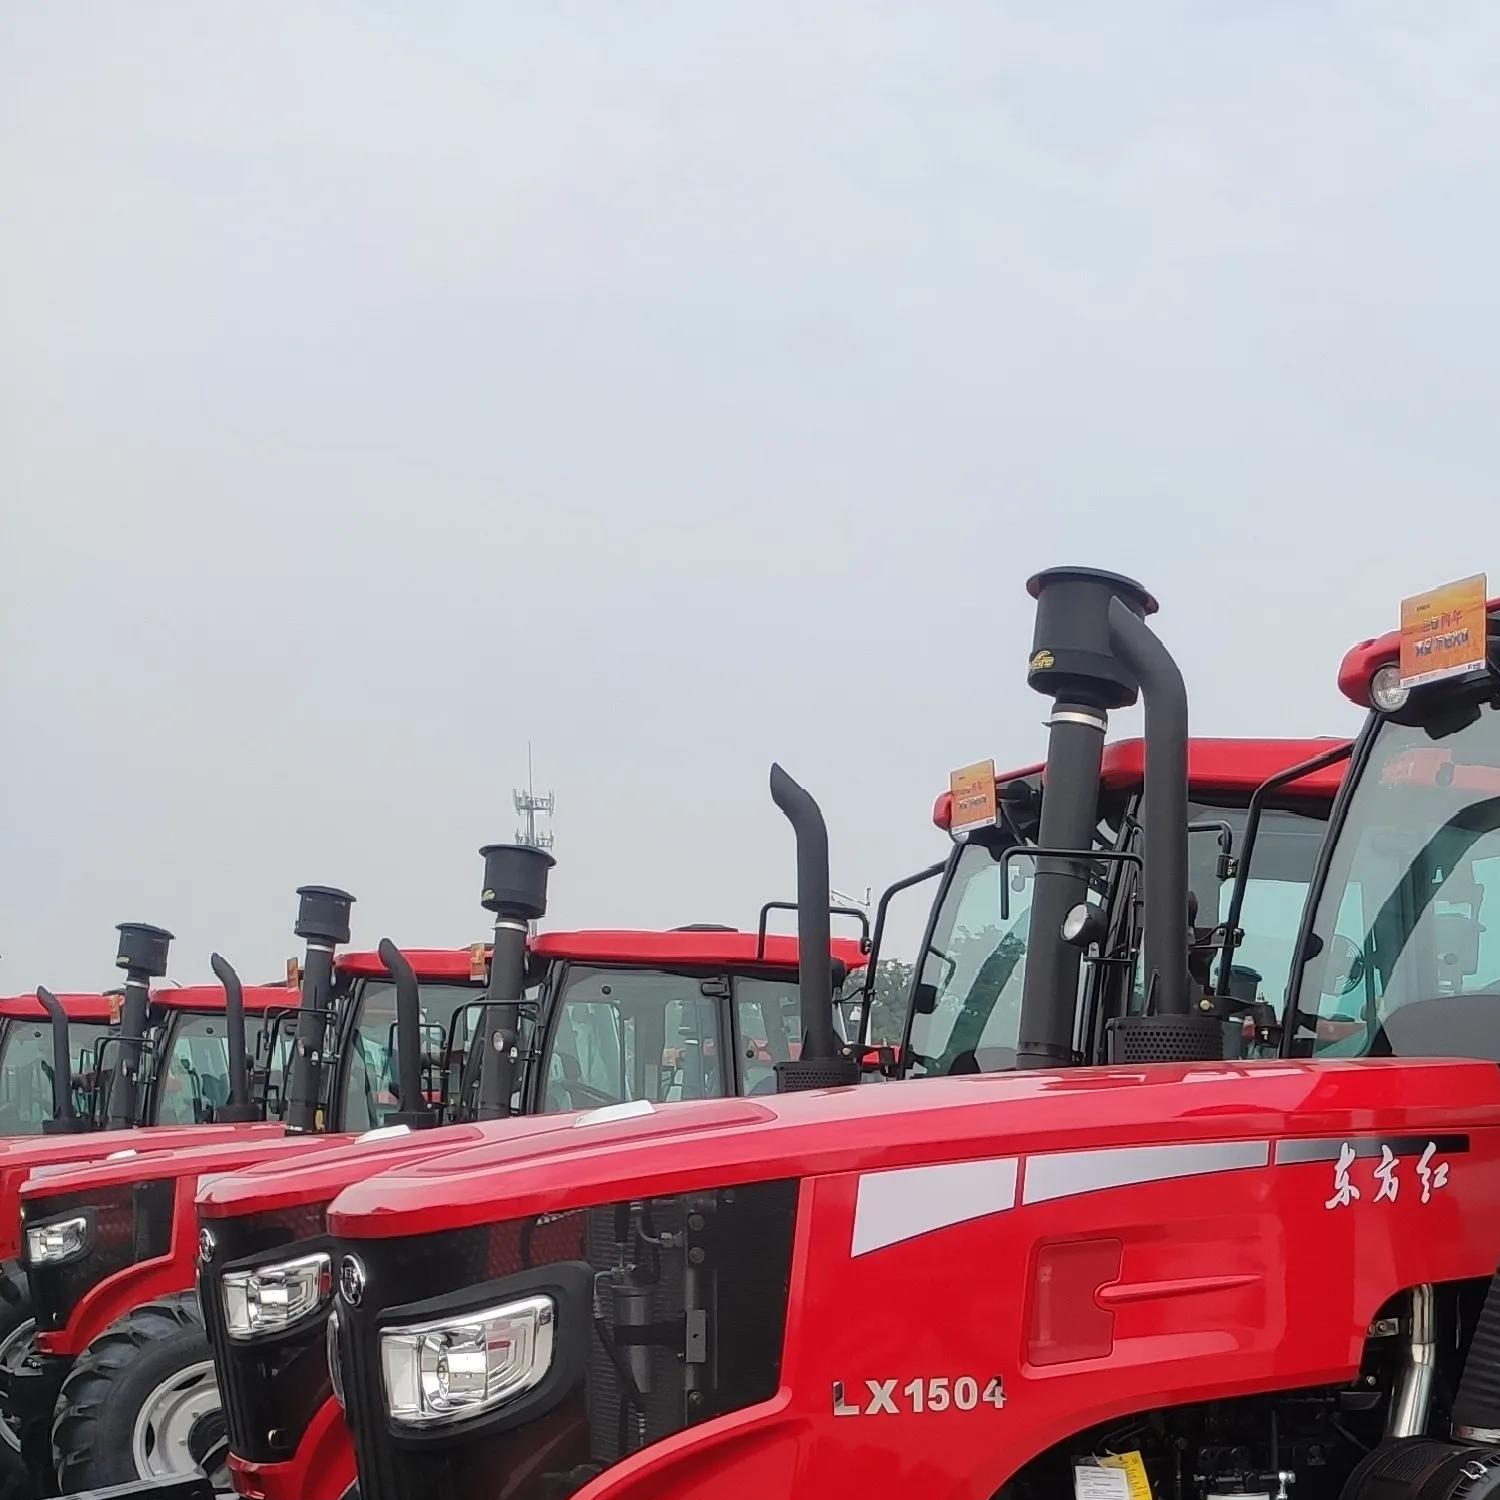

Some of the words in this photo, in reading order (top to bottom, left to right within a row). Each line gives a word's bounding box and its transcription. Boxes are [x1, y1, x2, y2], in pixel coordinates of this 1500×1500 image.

[1325, 1141, 1449, 1210] 东方红
[833, 1375, 1007, 1416] LX1504
